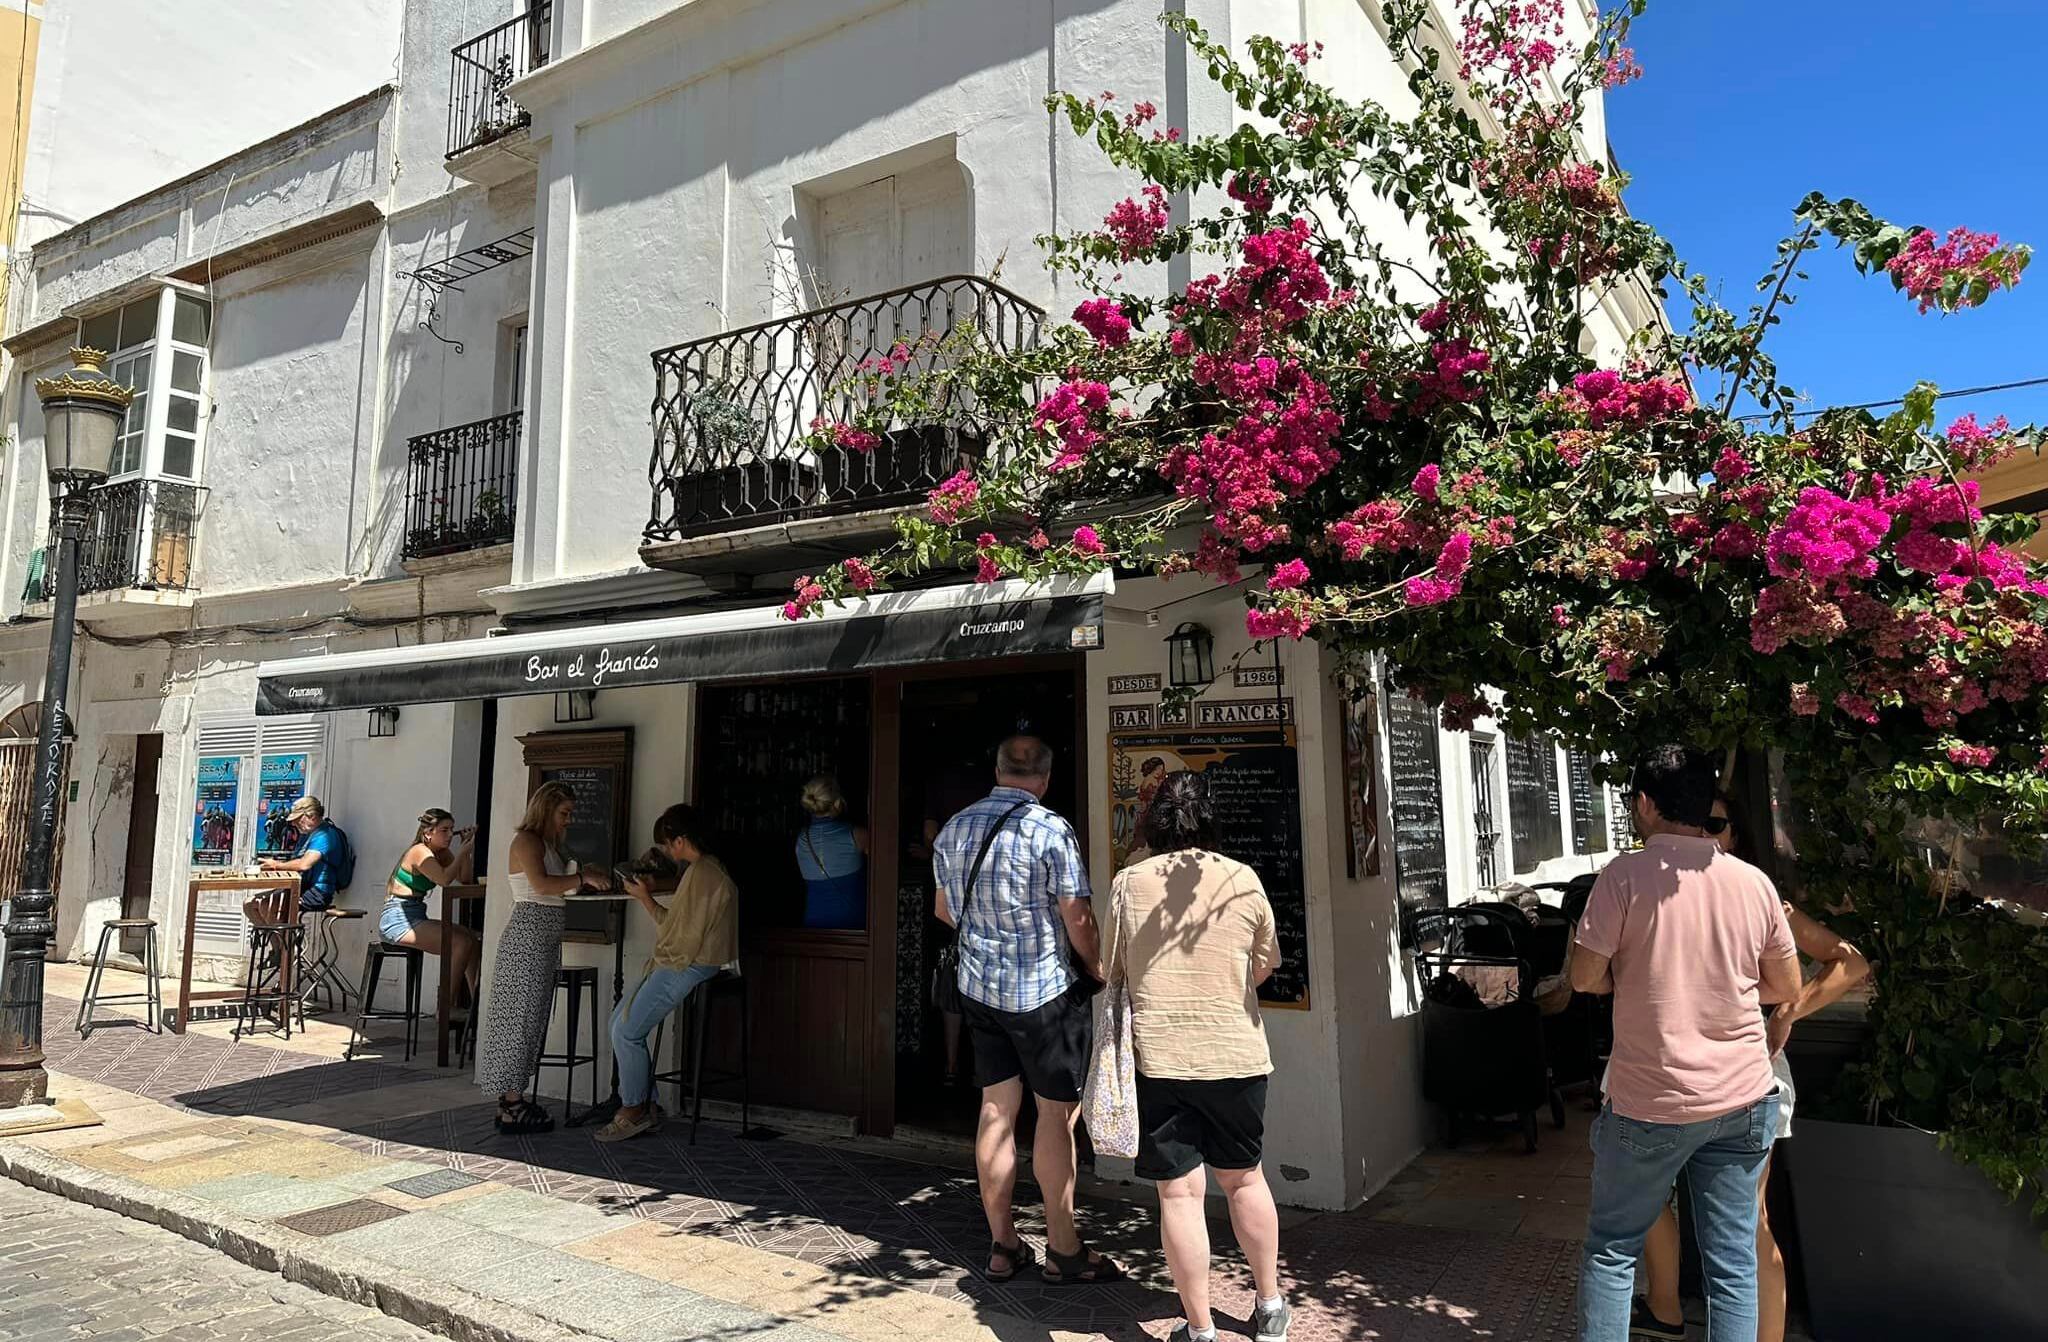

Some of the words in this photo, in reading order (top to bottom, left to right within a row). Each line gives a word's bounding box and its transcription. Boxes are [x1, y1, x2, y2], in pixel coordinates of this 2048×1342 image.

[960, 619, 1024, 637] Cruzcampo
[525, 656, 559, 682] Bar
[568, 655, 584, 676] el
[1115, 679, 1154, 690] DESDE
[1242, 672, 1276, 683] 1986
[1115, 710, 1148, 726] BAR
